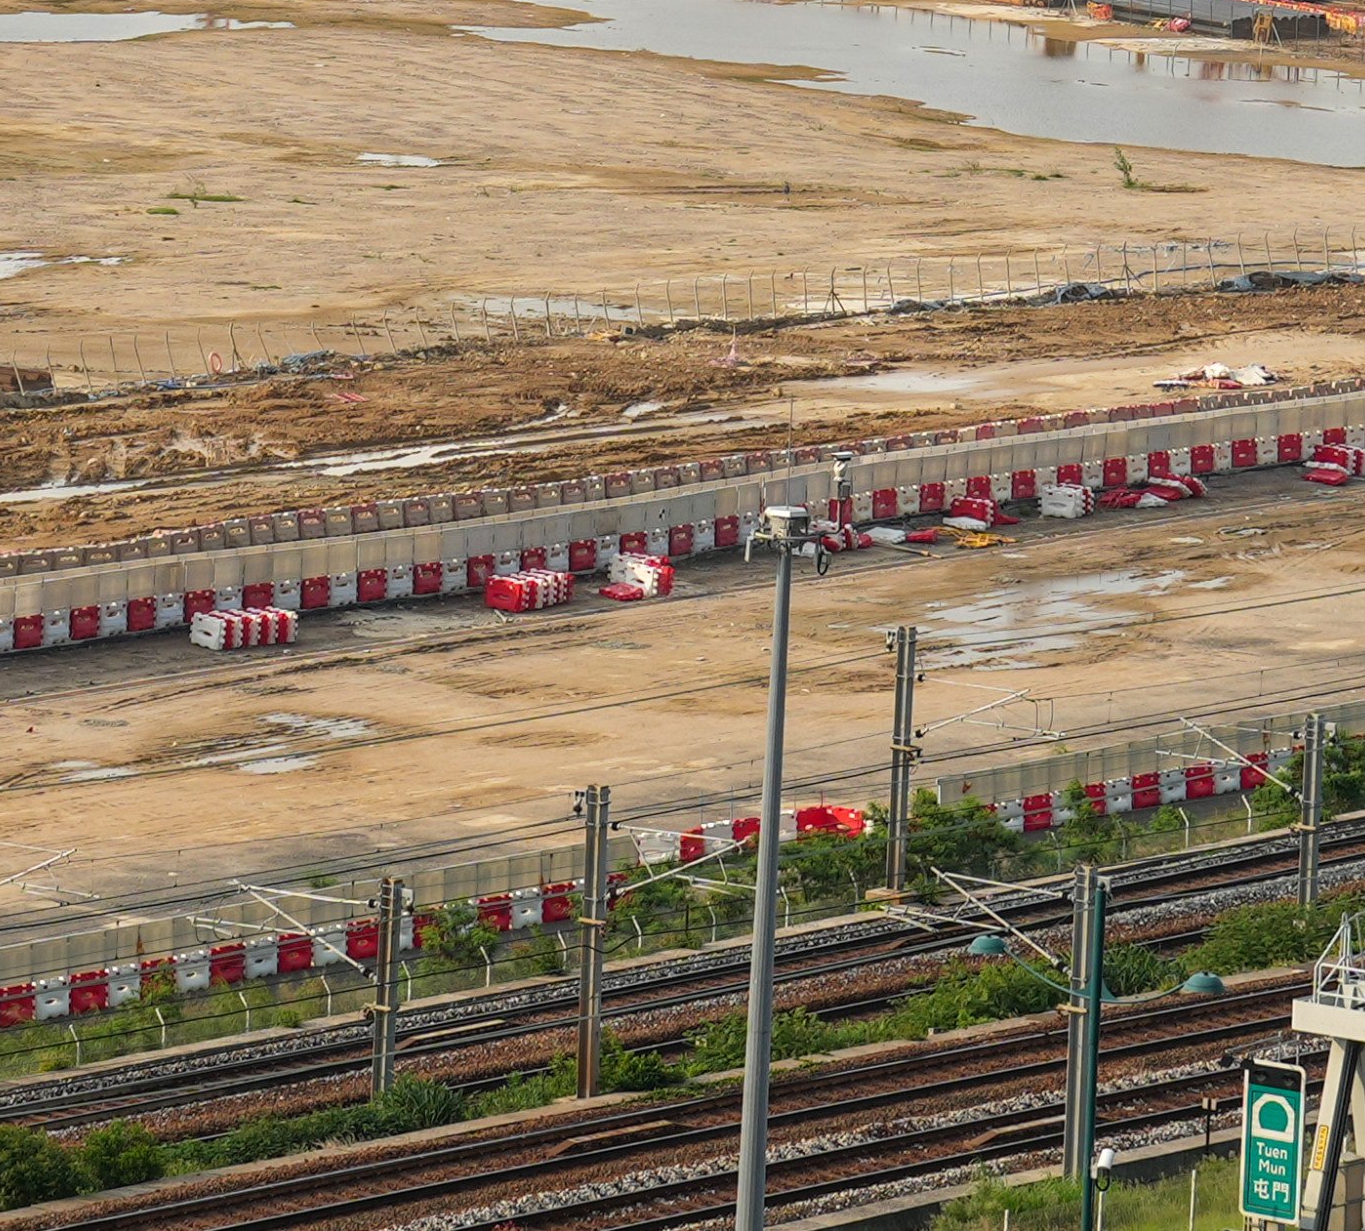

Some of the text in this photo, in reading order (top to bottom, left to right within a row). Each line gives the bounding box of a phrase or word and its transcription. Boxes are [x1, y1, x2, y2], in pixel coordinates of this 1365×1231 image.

[1256, 1141, 1288, 1160] Tuen
[1258, 1159, 1286, 1176] Mun
[1253, 1178, 1290, 1203] 屯門
